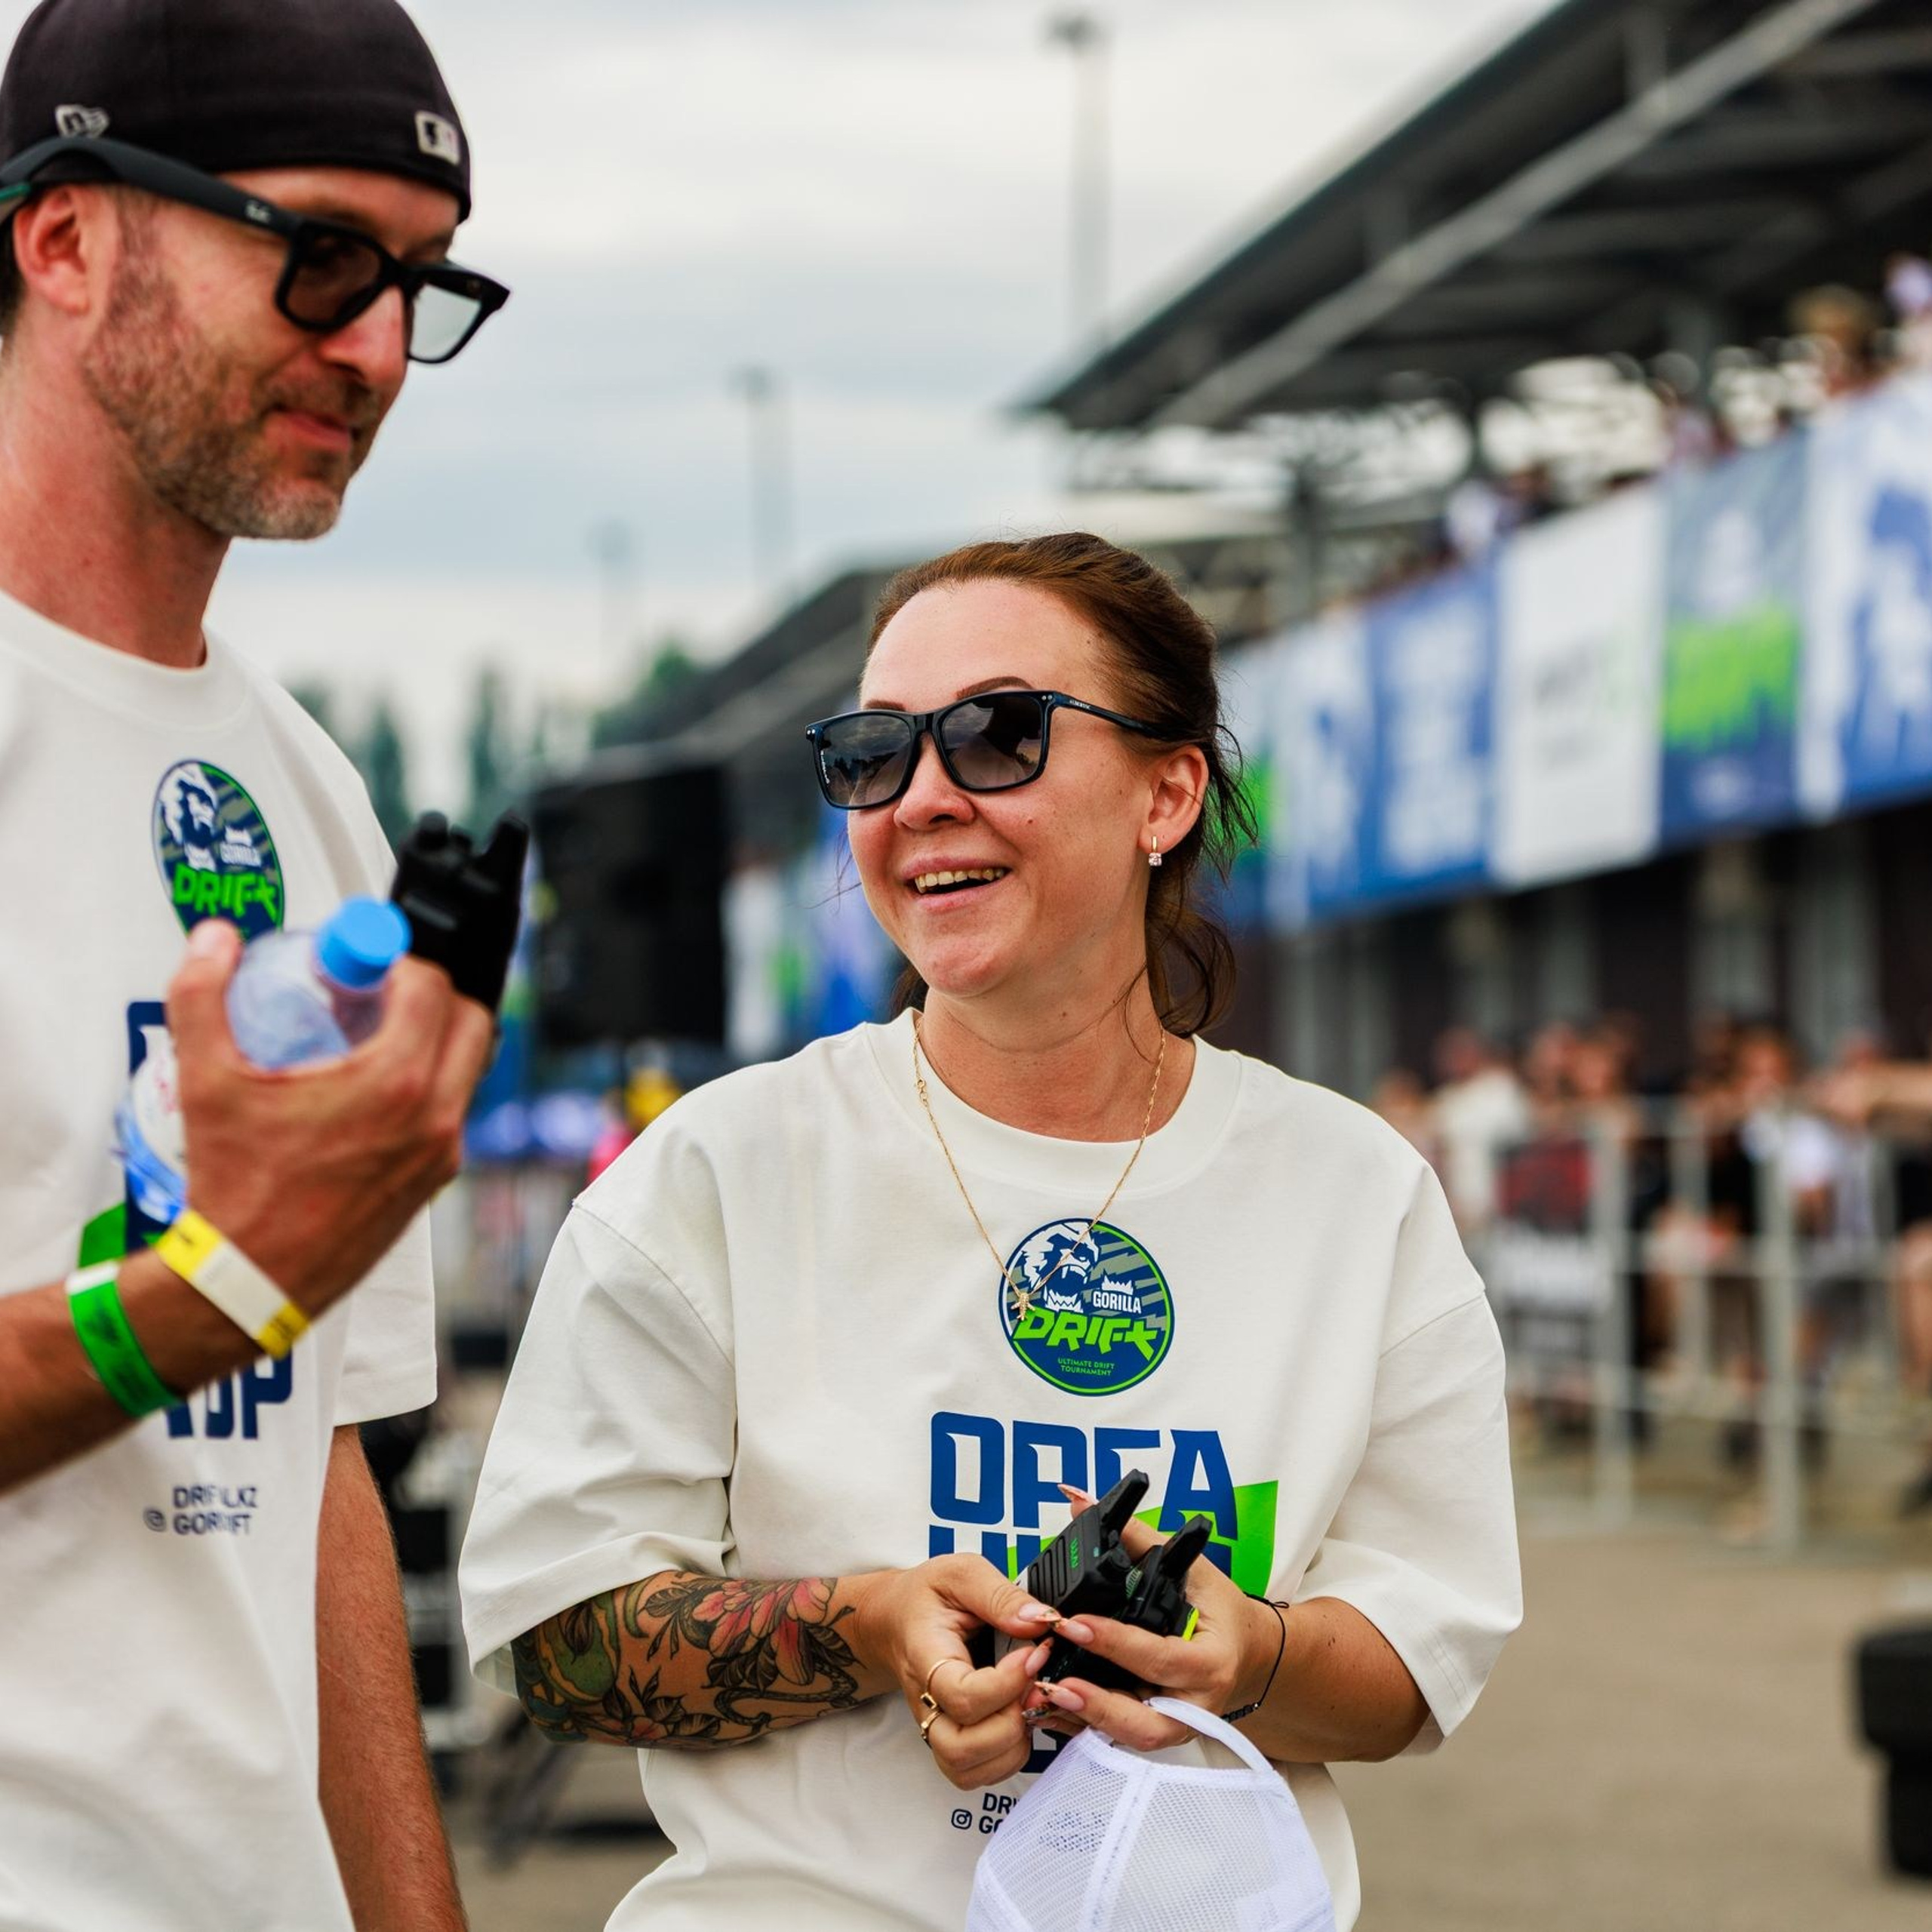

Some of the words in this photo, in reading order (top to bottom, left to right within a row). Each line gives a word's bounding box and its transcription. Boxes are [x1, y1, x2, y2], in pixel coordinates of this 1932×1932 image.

[174, 863, 278, 924] DRIFT
[1094, 1291, 1142, 1314] GORILLA
[1013, 1306, 1158, 1361] DRIFT
[1057, 1358, 1092, 1368] ULTIMATE
[1094, 1361, 1115, 1370] DRIFT
[1060, 1365, 1112, 1377] TOURNAMENT
